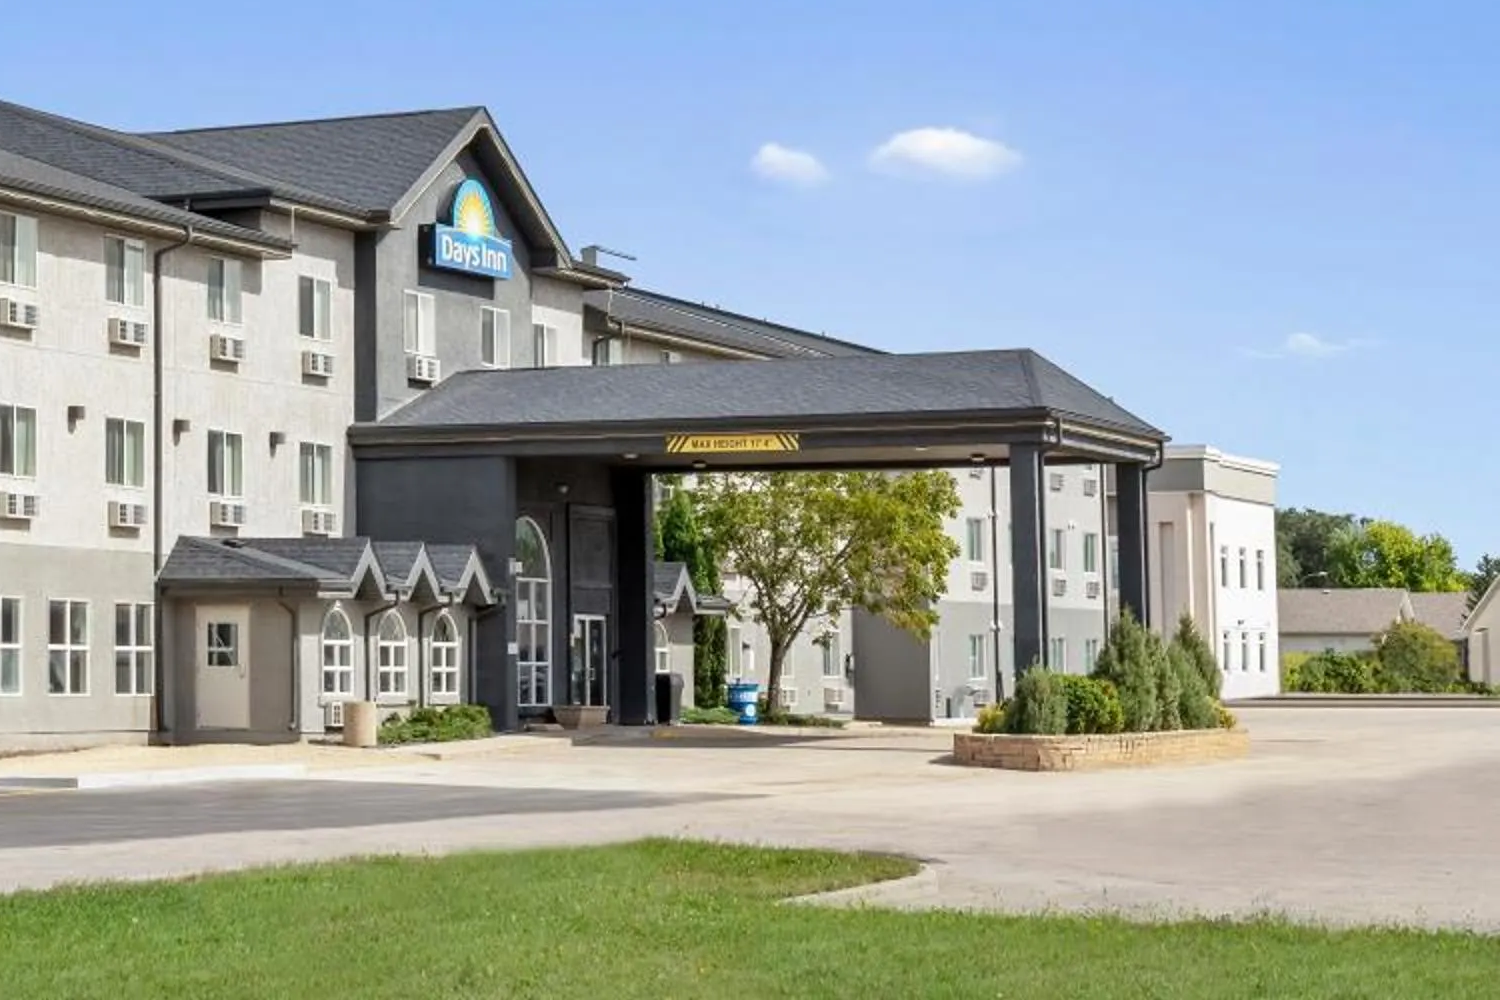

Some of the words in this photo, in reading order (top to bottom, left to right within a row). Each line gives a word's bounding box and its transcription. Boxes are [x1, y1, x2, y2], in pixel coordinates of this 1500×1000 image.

[441, 235, 480, 269] Days
[481, 242, 507, 273] Inn
[691, 439, 711, 449] MAX
[713, 439, 747, 449] HEIGHT
